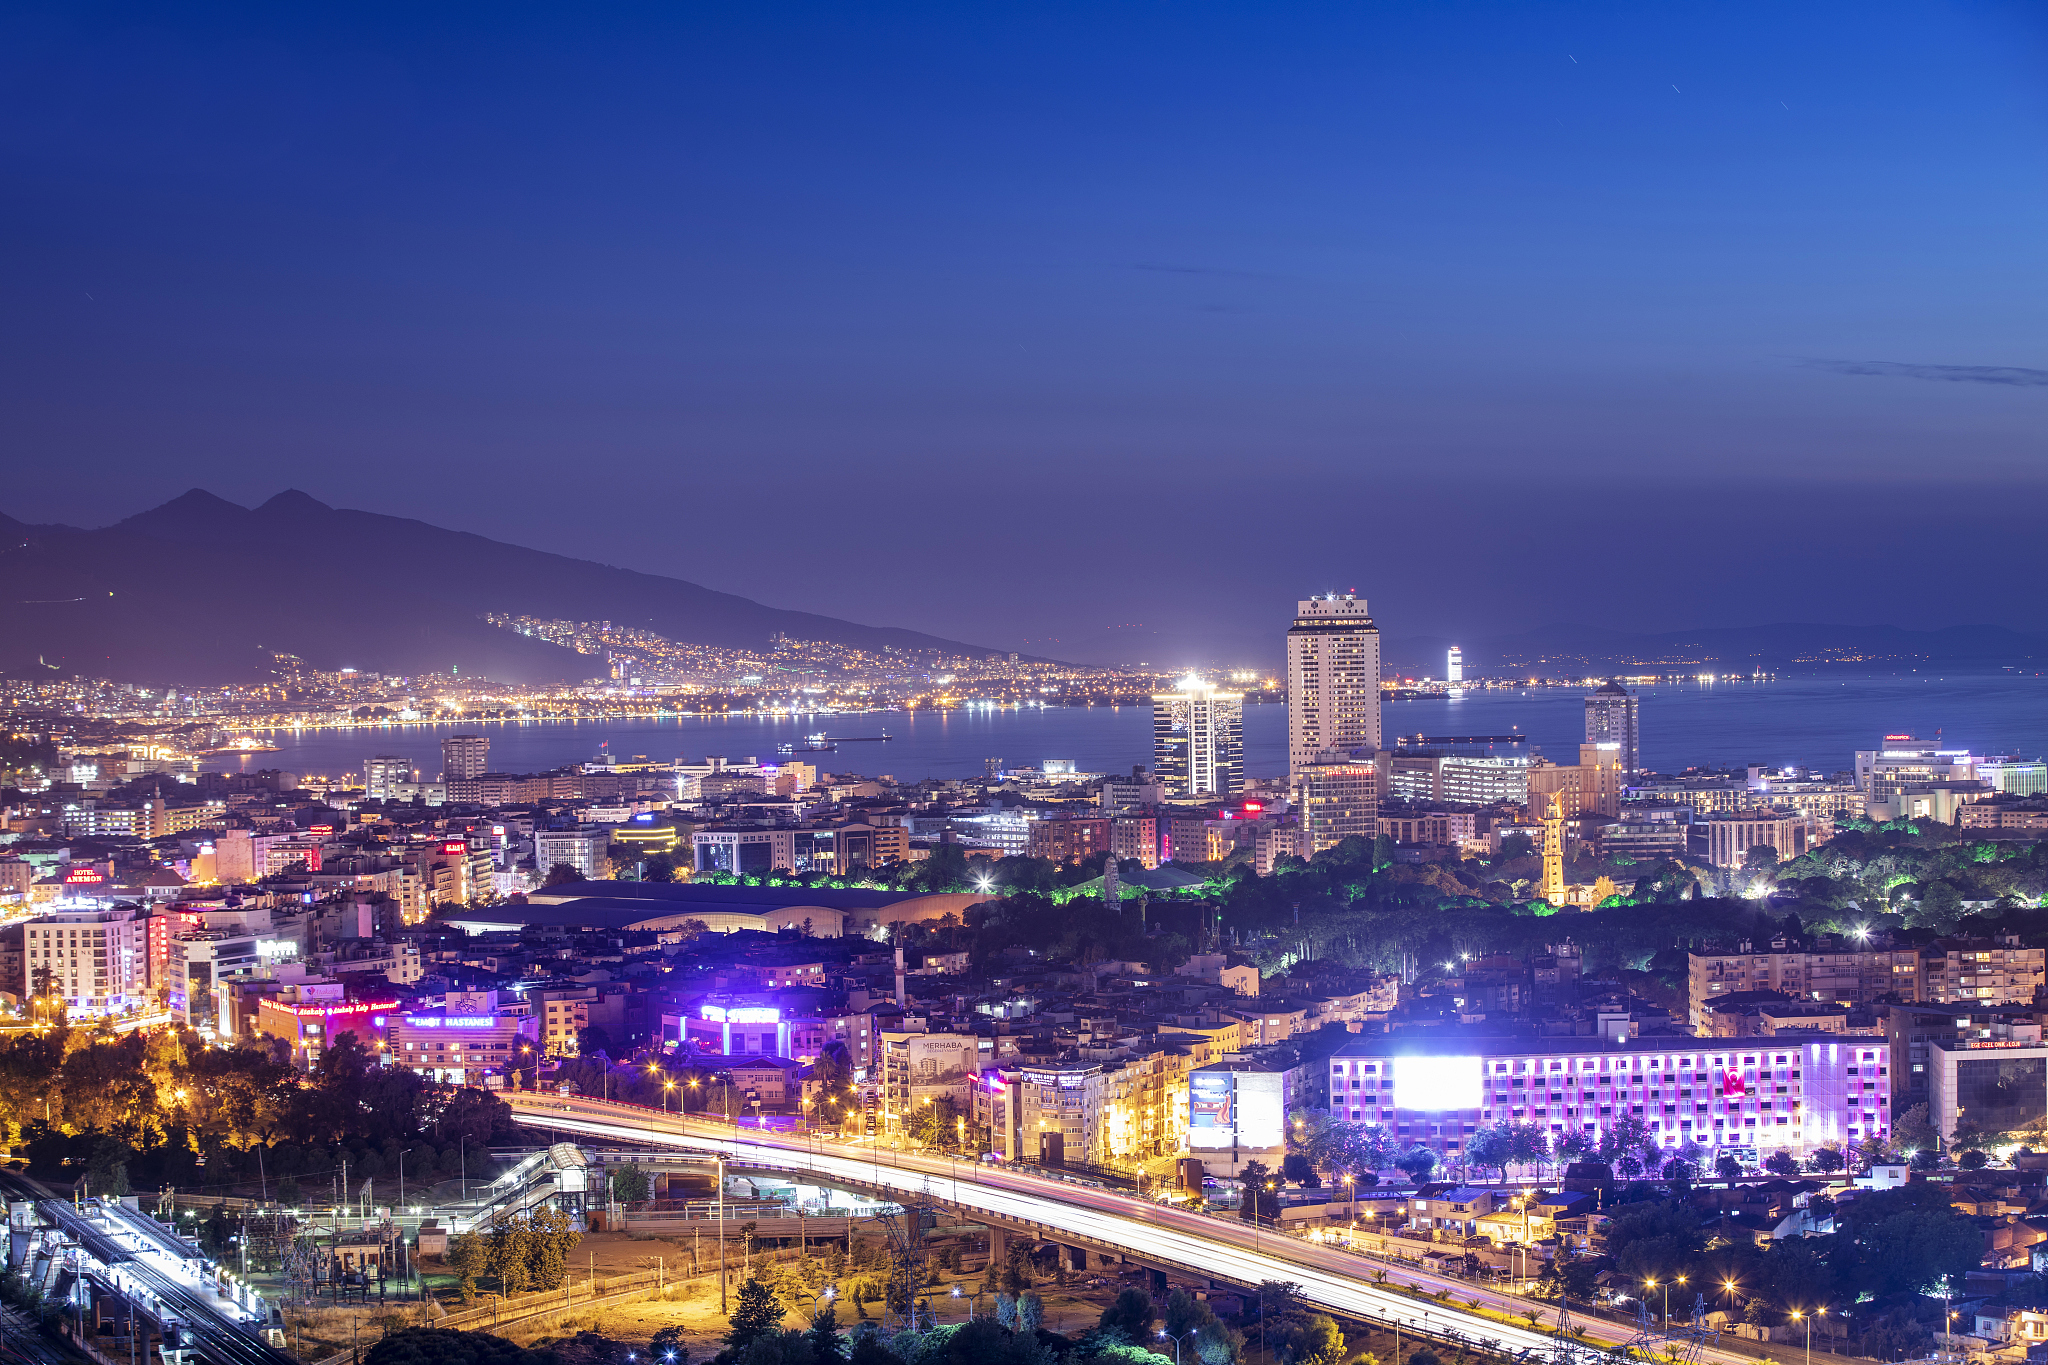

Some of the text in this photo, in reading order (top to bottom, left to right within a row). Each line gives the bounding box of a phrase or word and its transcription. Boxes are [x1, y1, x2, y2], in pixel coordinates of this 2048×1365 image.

[160, 916, 168, 960] ANEMON
[314, 987, 339, 997] Atakalp
[298, 1007, 326, 1017] Atakalp
